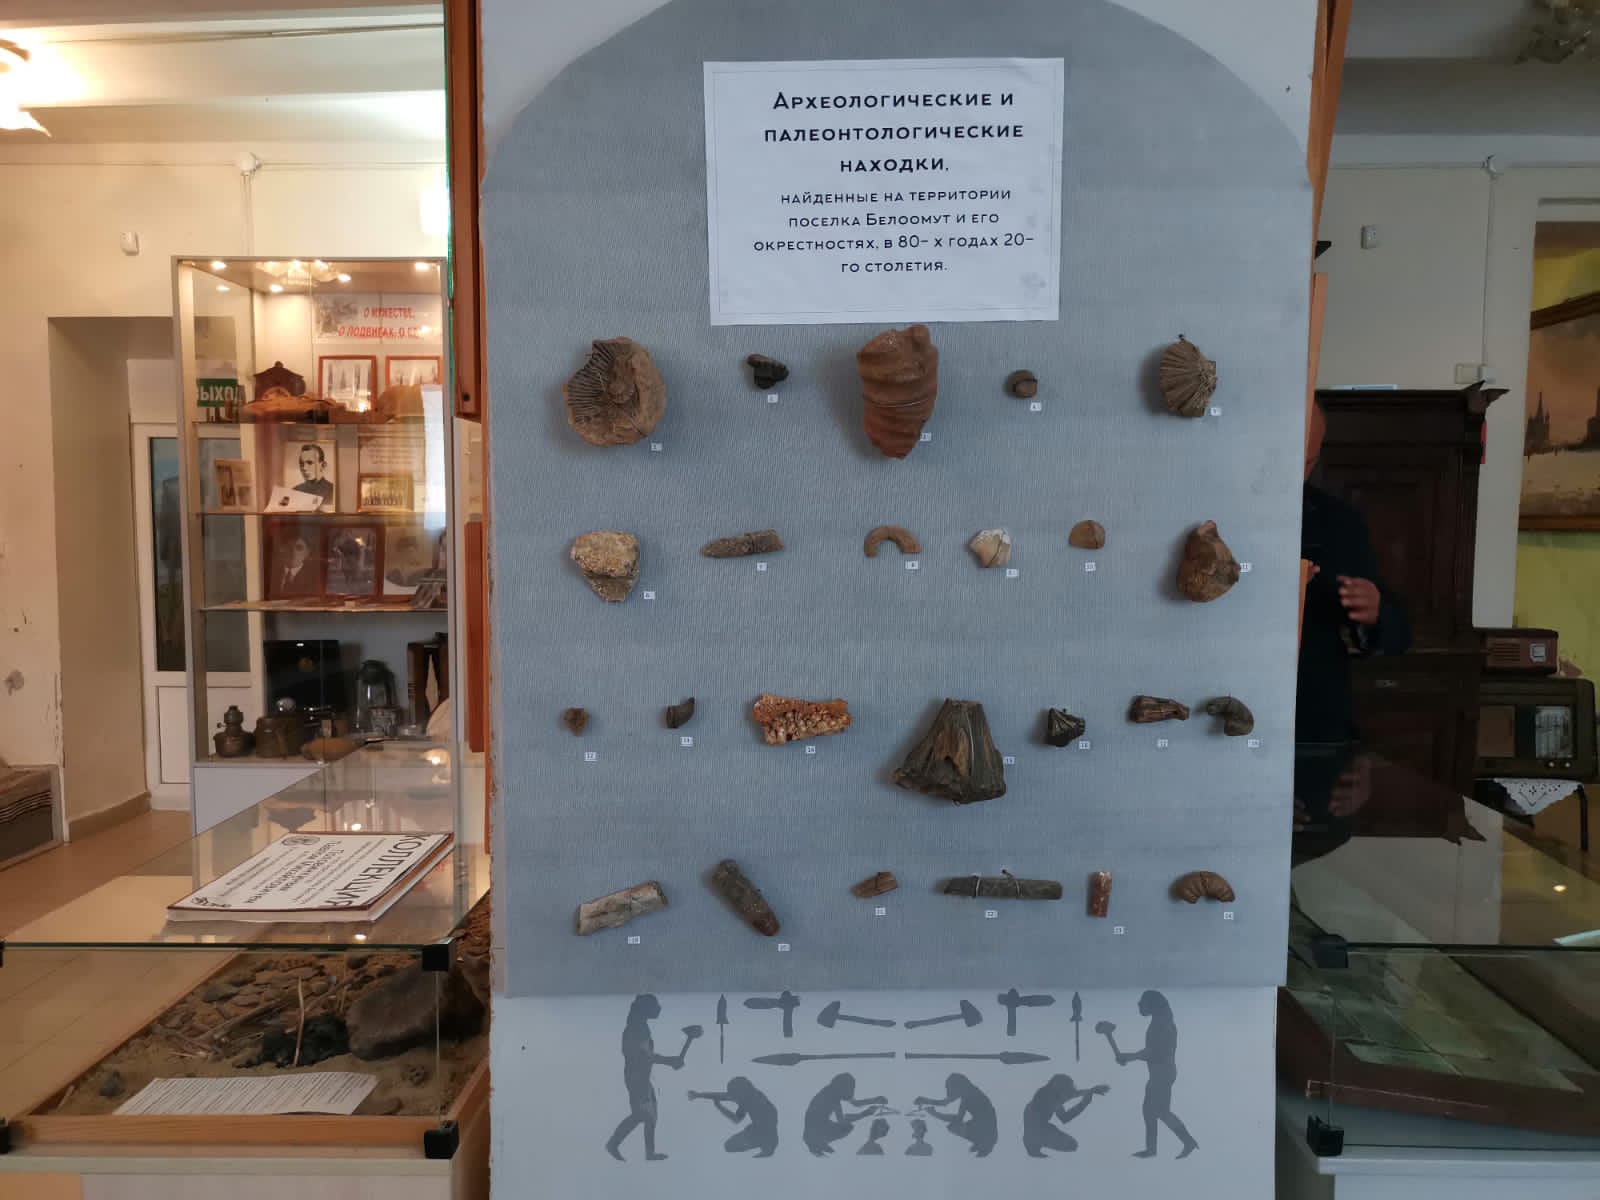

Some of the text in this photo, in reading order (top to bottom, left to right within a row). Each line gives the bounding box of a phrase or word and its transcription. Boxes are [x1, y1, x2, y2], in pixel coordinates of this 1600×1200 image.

[1001, 93, 1014, 106] И
[884, 192, 904, 202] НА
[956, 214, 966, 224] И
